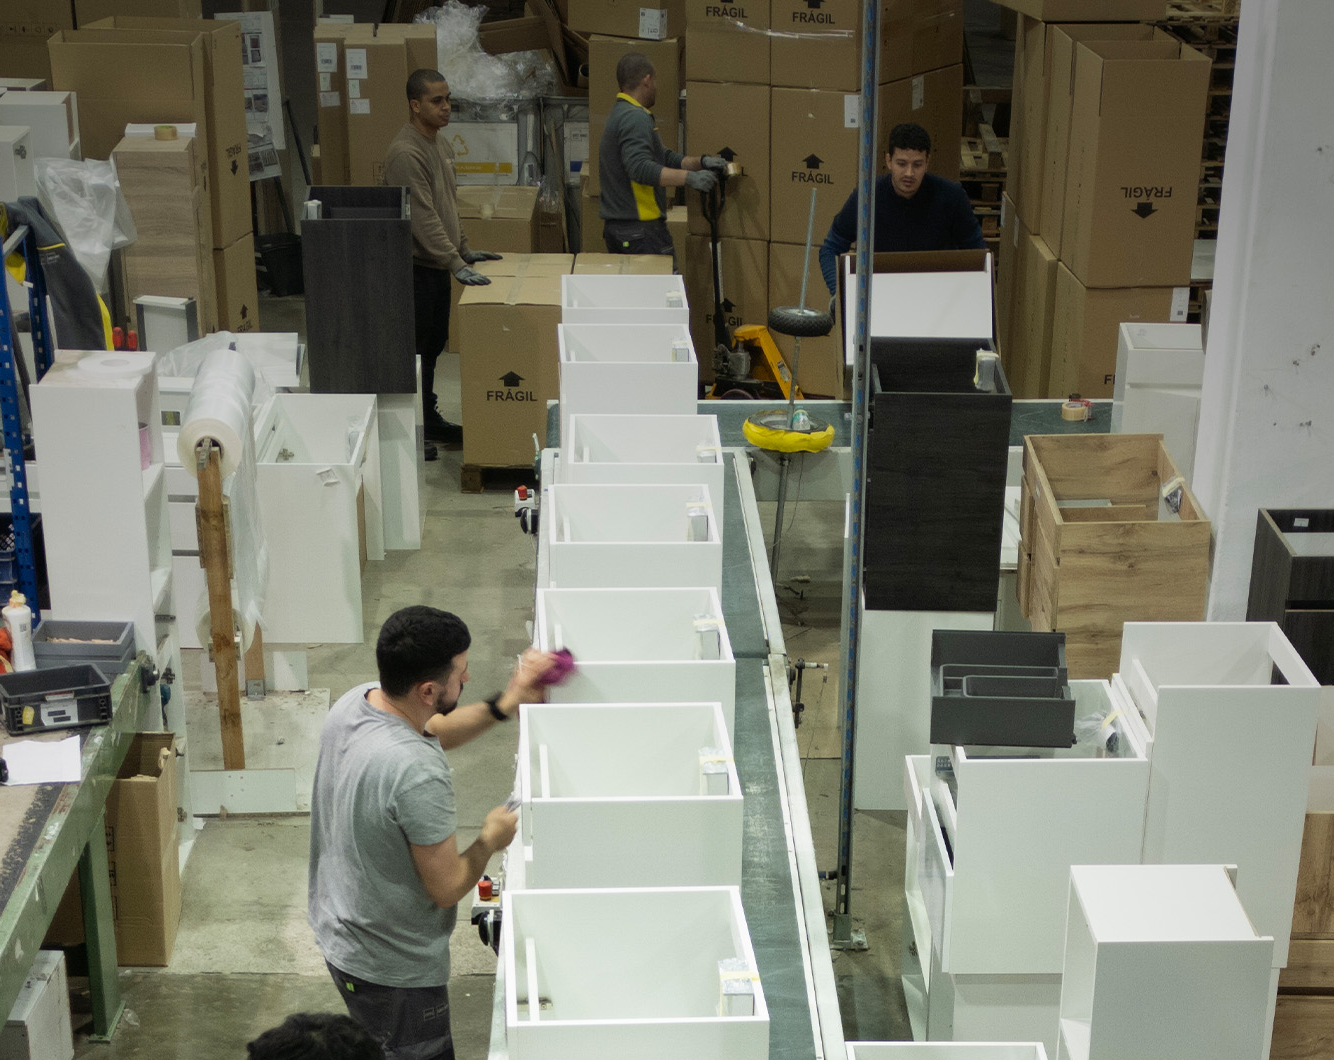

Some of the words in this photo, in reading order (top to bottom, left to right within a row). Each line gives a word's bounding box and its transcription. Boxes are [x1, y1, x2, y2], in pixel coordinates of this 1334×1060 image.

[705, 5, 748, 18] FRÁGIL
[792, 11, 835, 24] FRÁGIL
[791, 170, 834, 184] FRÁGIL
[1120, 186, 1173, 200] FRÁGIL
[486, 388, 538, 401] FRÁGIL
